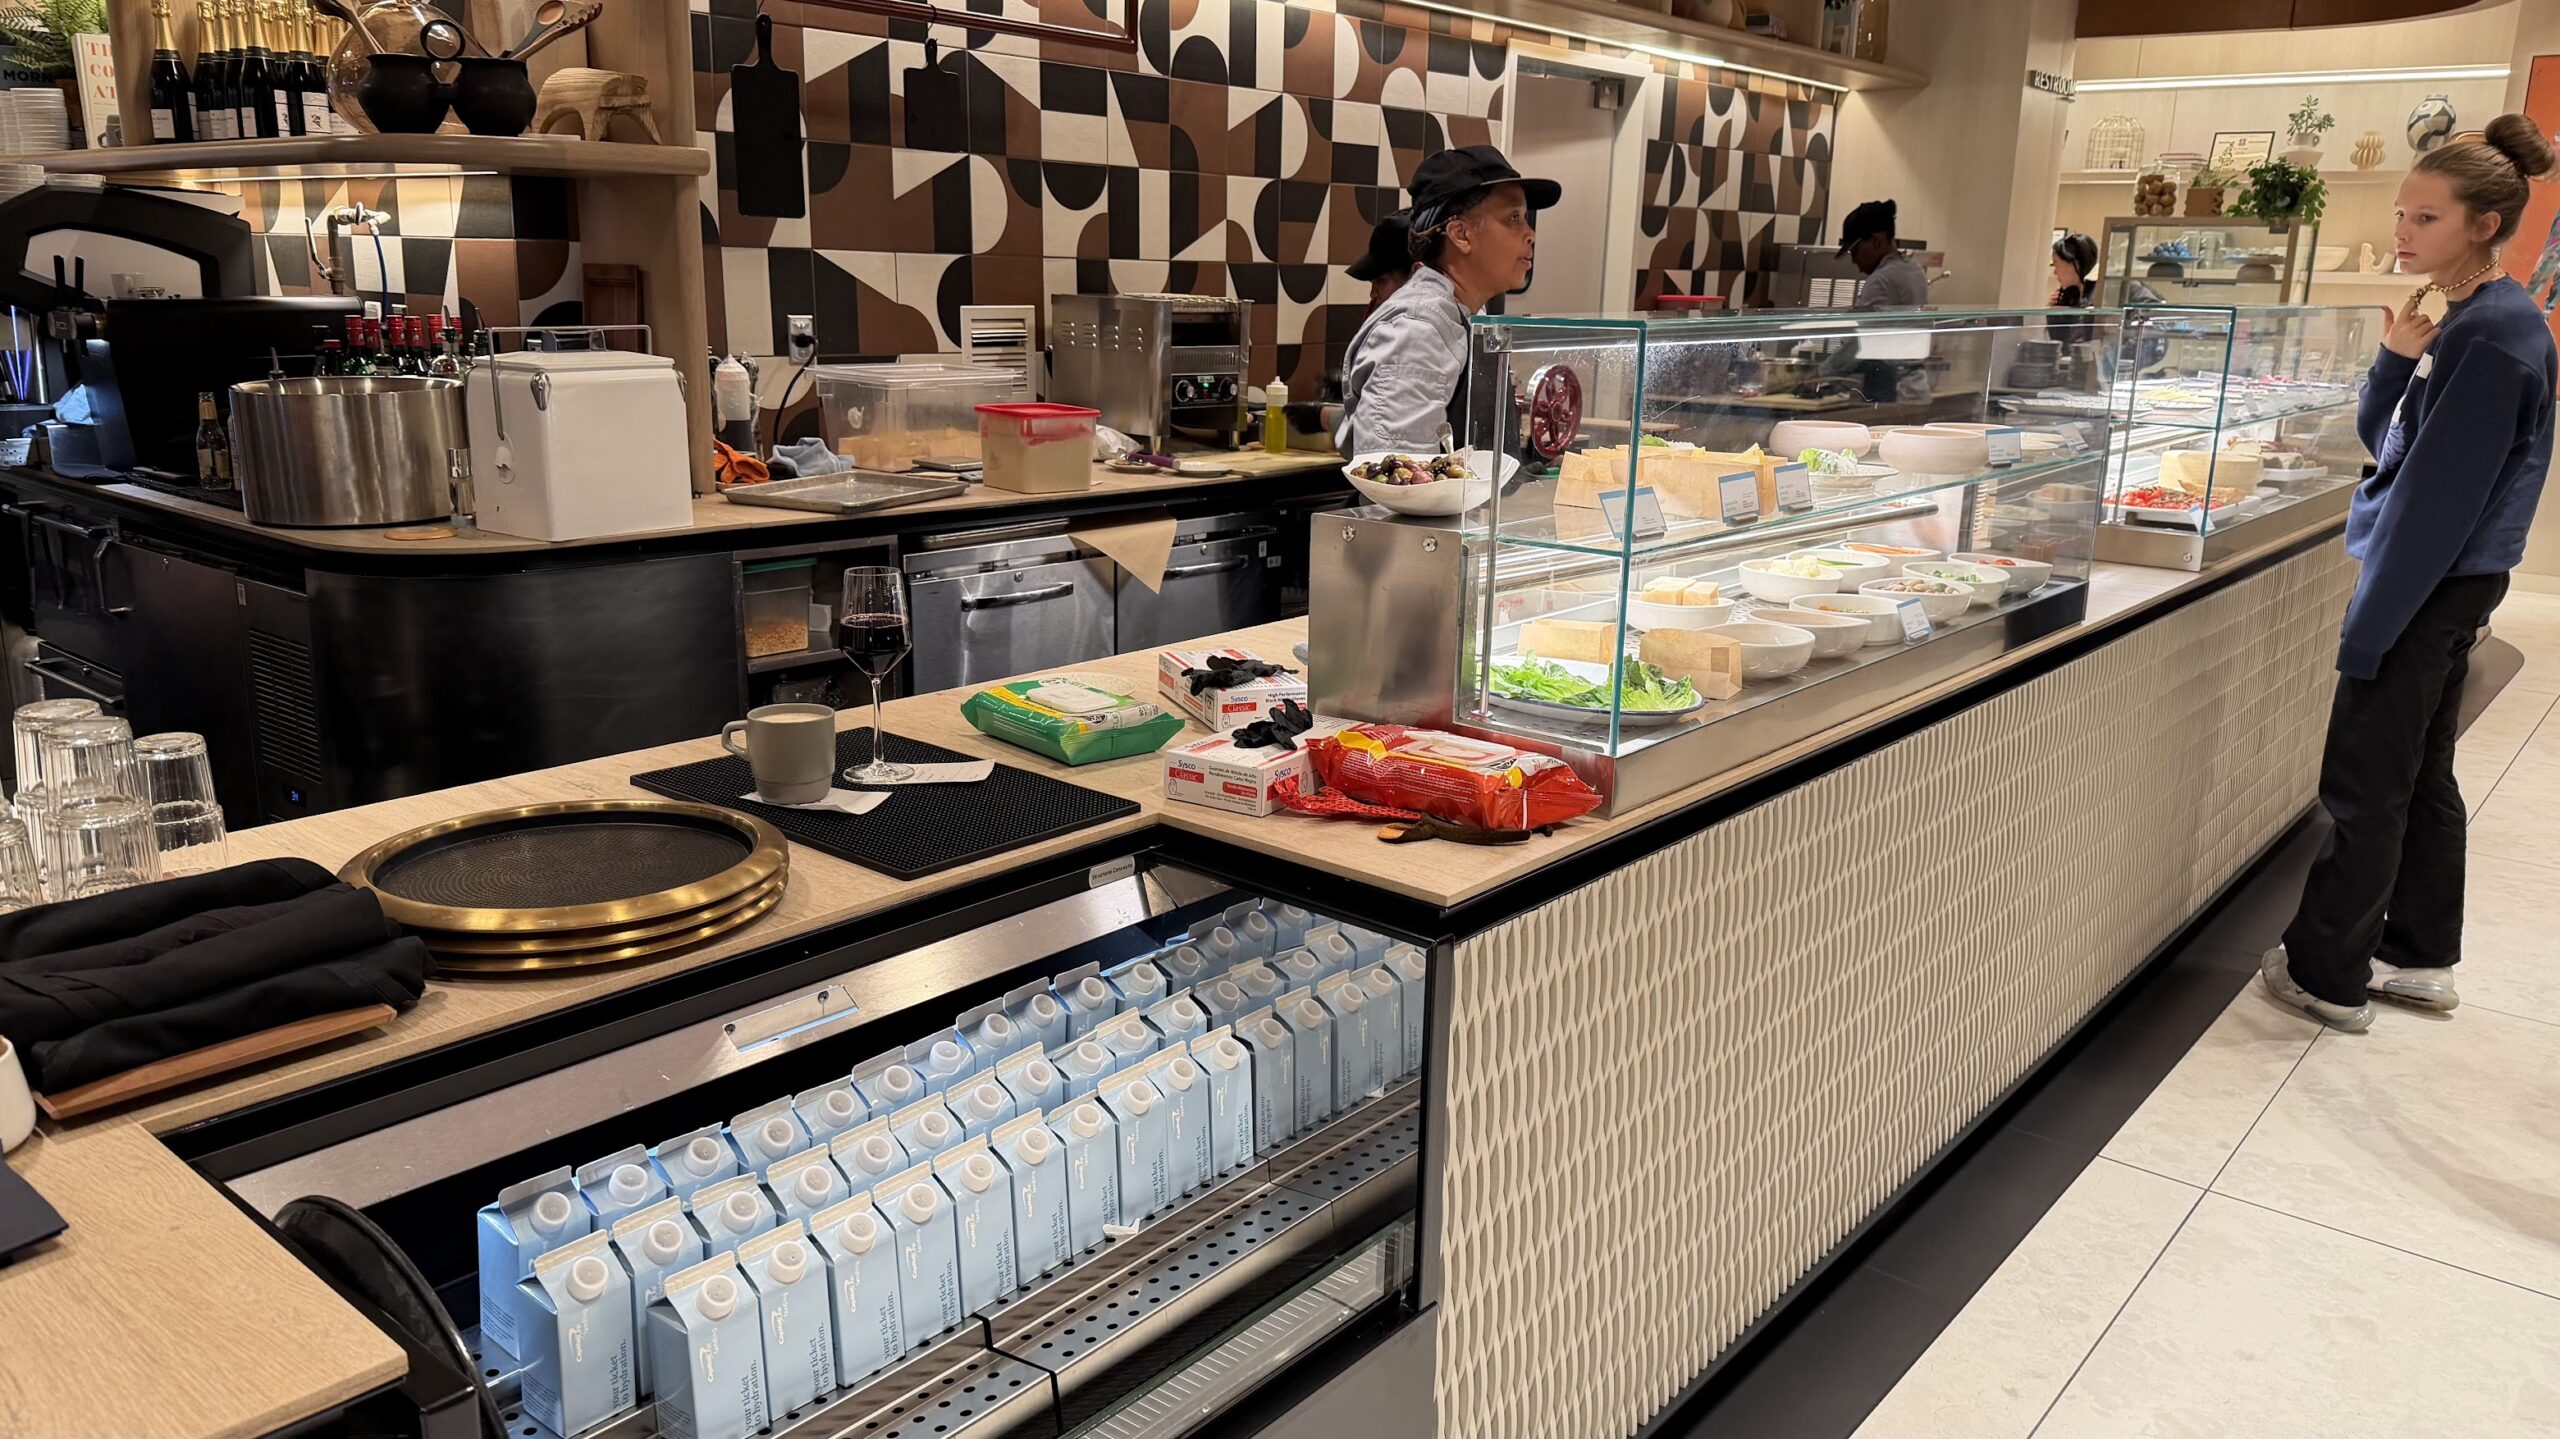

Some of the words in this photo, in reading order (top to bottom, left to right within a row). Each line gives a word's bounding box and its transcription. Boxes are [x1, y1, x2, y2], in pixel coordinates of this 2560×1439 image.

[1227, 703, 1251, 713] Classic
[1230, 695, 1249, 703] Sysco
[1174, 769, 1198, 780] Classic
[1178, 760, 1196, 770] Sysco
[1274, 768, 1291, 781] Sysco
[1004, 1228, 1013, 1279] hydration.
[1060, 1252, 1066, 1260] to
[946, 1258, 957, 1315] hydration.
[998, 1269, 1007, 1291] your
[1006, 1279, 1012, 1287] to
[888, 1291, 899, 1347] hydration.
[942, 1304, 950, 1326] your
[810, 1338, 818, 1367] ticket
[818, 1322, 830, 1380] hydration.
[882, 1336, 892, 1360] your
[891, 1347, 899, 1356] to
[610, 1355, 618, 1389] ticket
[619, 1339, 630, 1396] hydration.
[750, 1359, 761, 1416] hydration.
[812, 1367, 822, 1393] your
[821, 1380, 831, 1388] to
[612, 1390, 622, 1409] your
[621, 1396, 630, 1405] to
[741, 1376, 749, 1409] ticket
[743, 1409, 752, 1432] your
[753, 1416, 761, 1427] to
